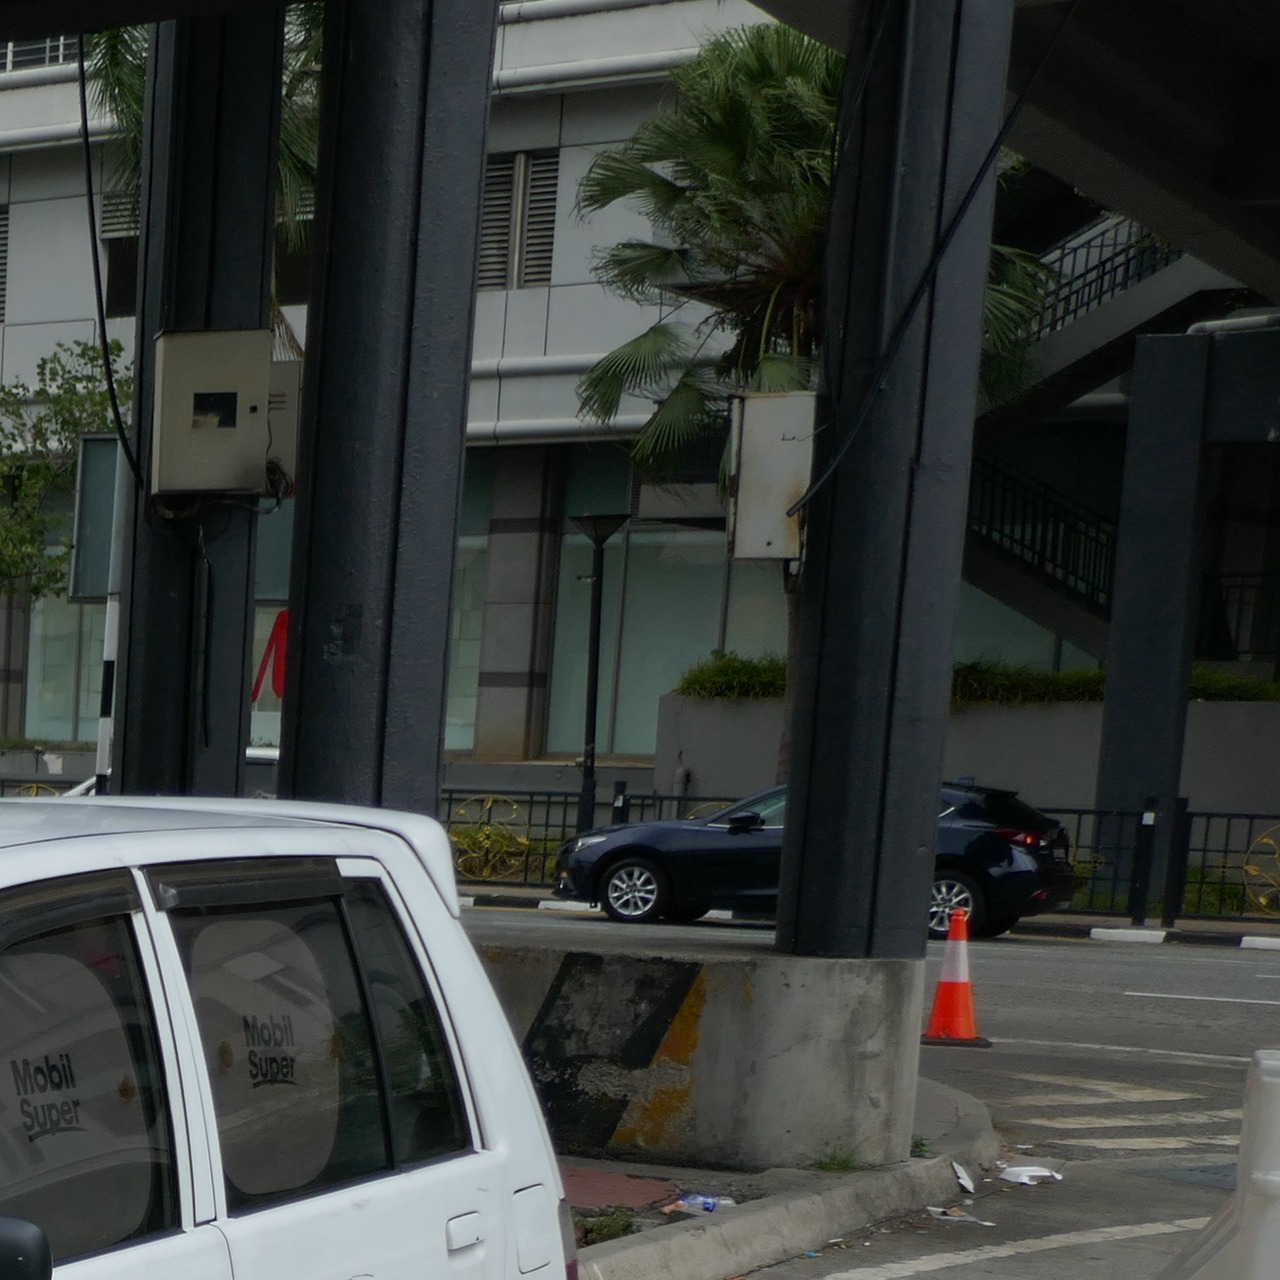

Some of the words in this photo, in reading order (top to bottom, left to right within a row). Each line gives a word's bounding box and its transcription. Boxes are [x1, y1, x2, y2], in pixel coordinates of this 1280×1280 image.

[242, 1014, 294, 1047] Mobil
[10, 1054, 76, 1096] Mobil
[248, 1050, 295, 1086] Super
[20, 1098, 80, 1135] Super
